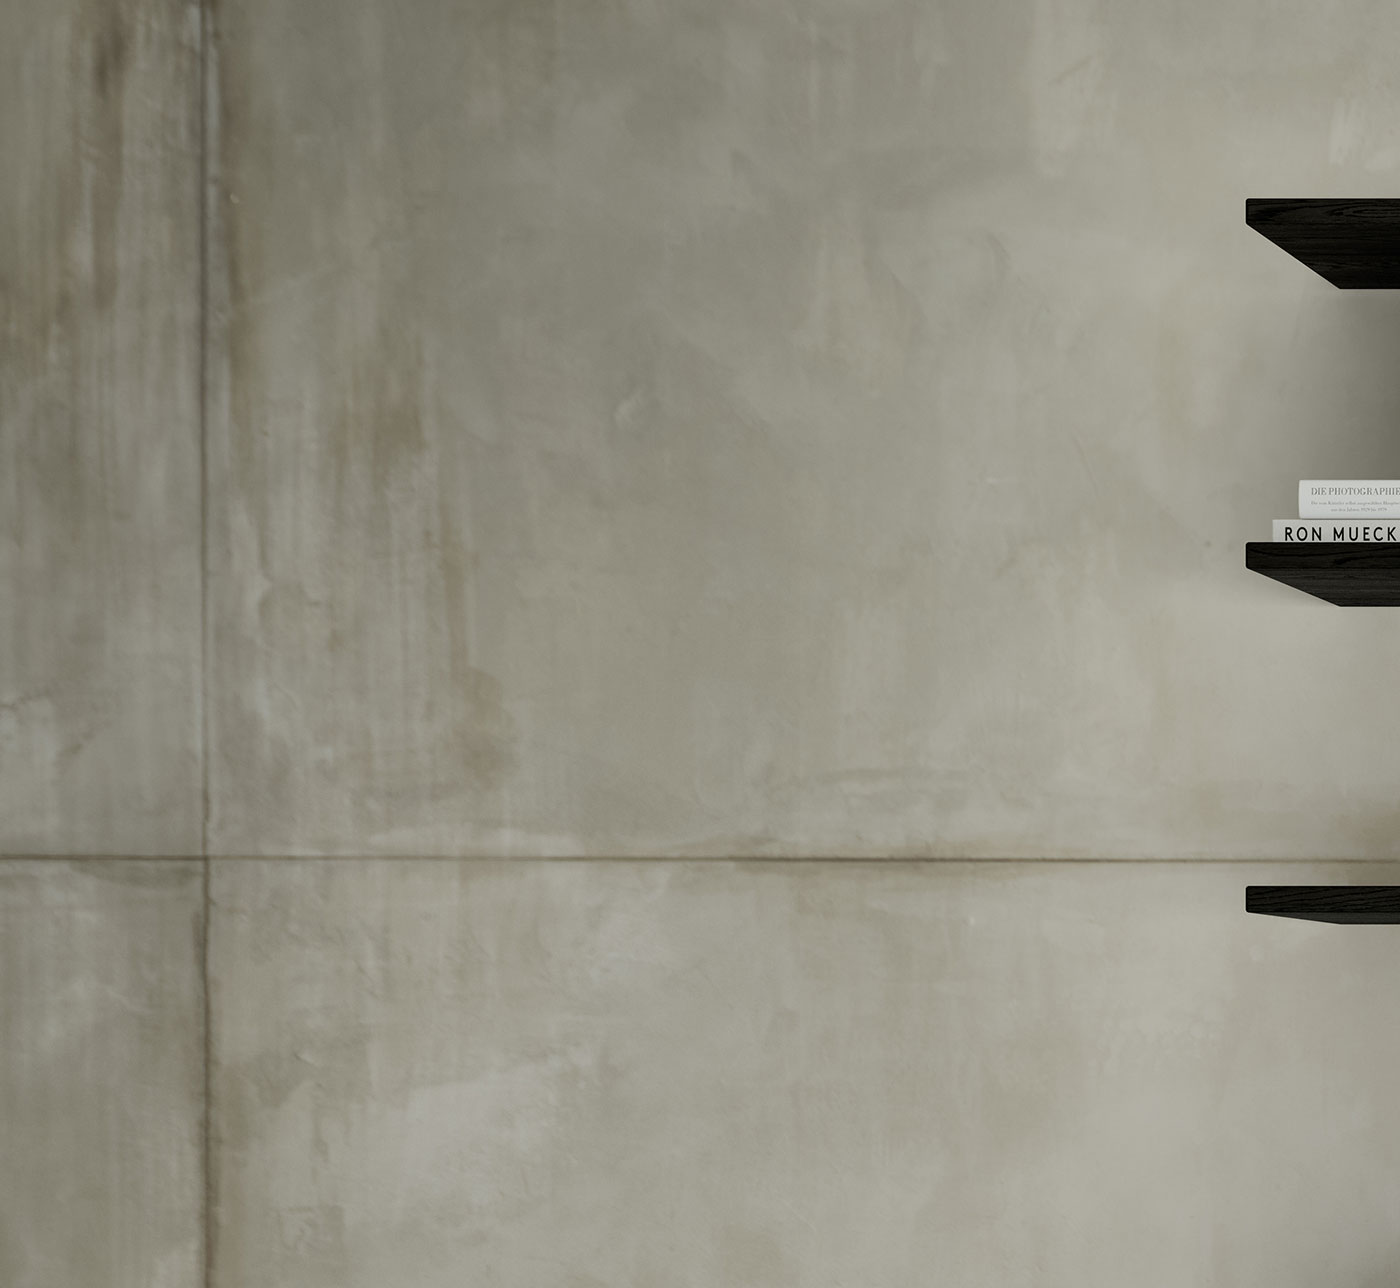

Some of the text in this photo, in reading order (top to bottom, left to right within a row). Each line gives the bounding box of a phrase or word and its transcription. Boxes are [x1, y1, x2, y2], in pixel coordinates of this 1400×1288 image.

[1311, 487, 1327, 496] DIE
[1284, 527, 1397, 541] RON MUECK
